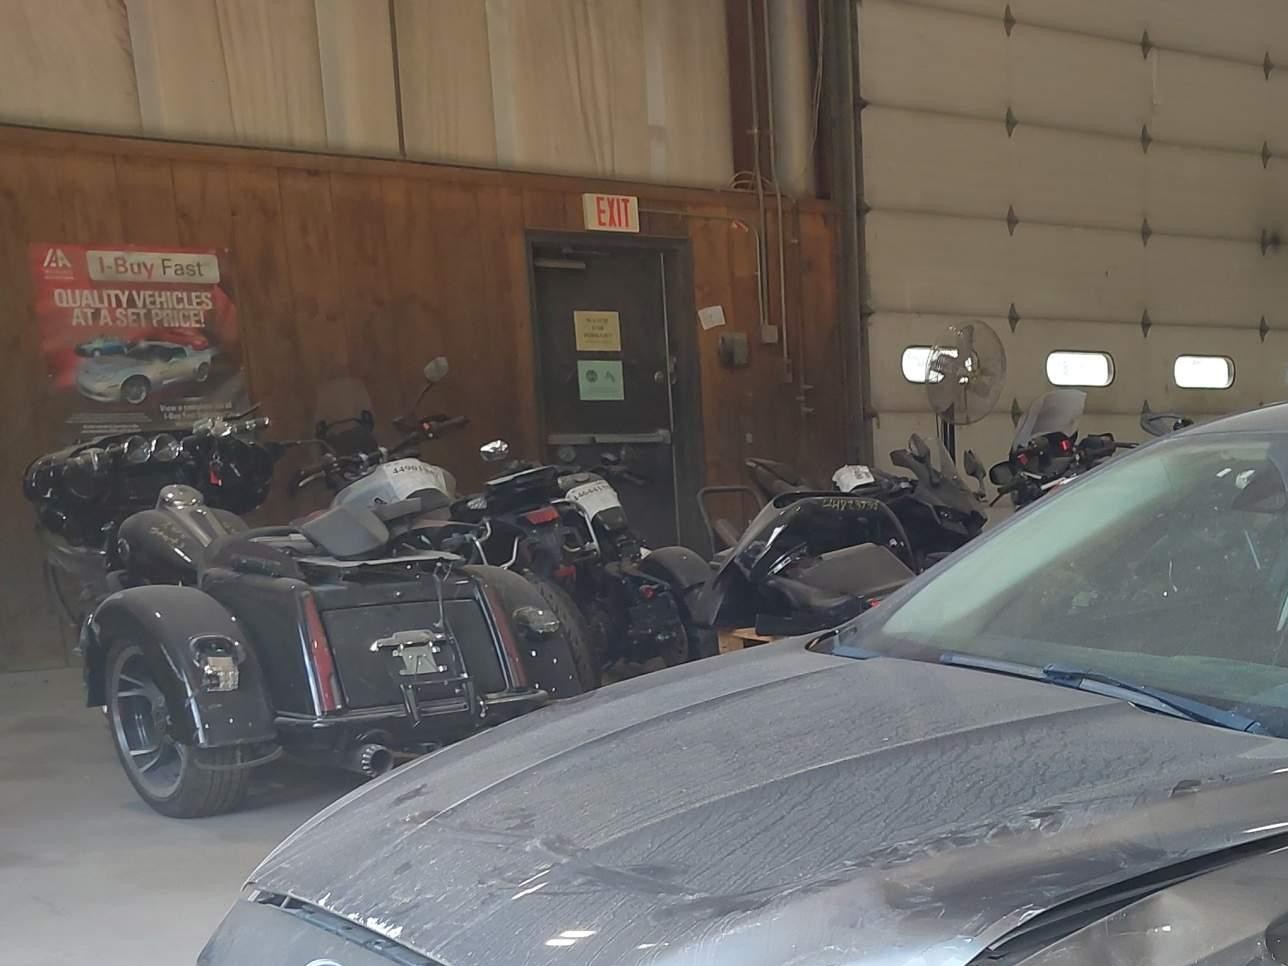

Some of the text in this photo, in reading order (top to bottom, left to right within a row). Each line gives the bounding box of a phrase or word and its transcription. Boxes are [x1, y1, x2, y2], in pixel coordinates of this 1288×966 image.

[596, 196, 630, 228] EXIT
[98, 256, 154, 279] I-Buy
[162, 258, 204, 277] Fast
[54, 288, 213, 310] QUALITY VEHICLES
[72, 308, 206, 328] AT A SET PRICE!
